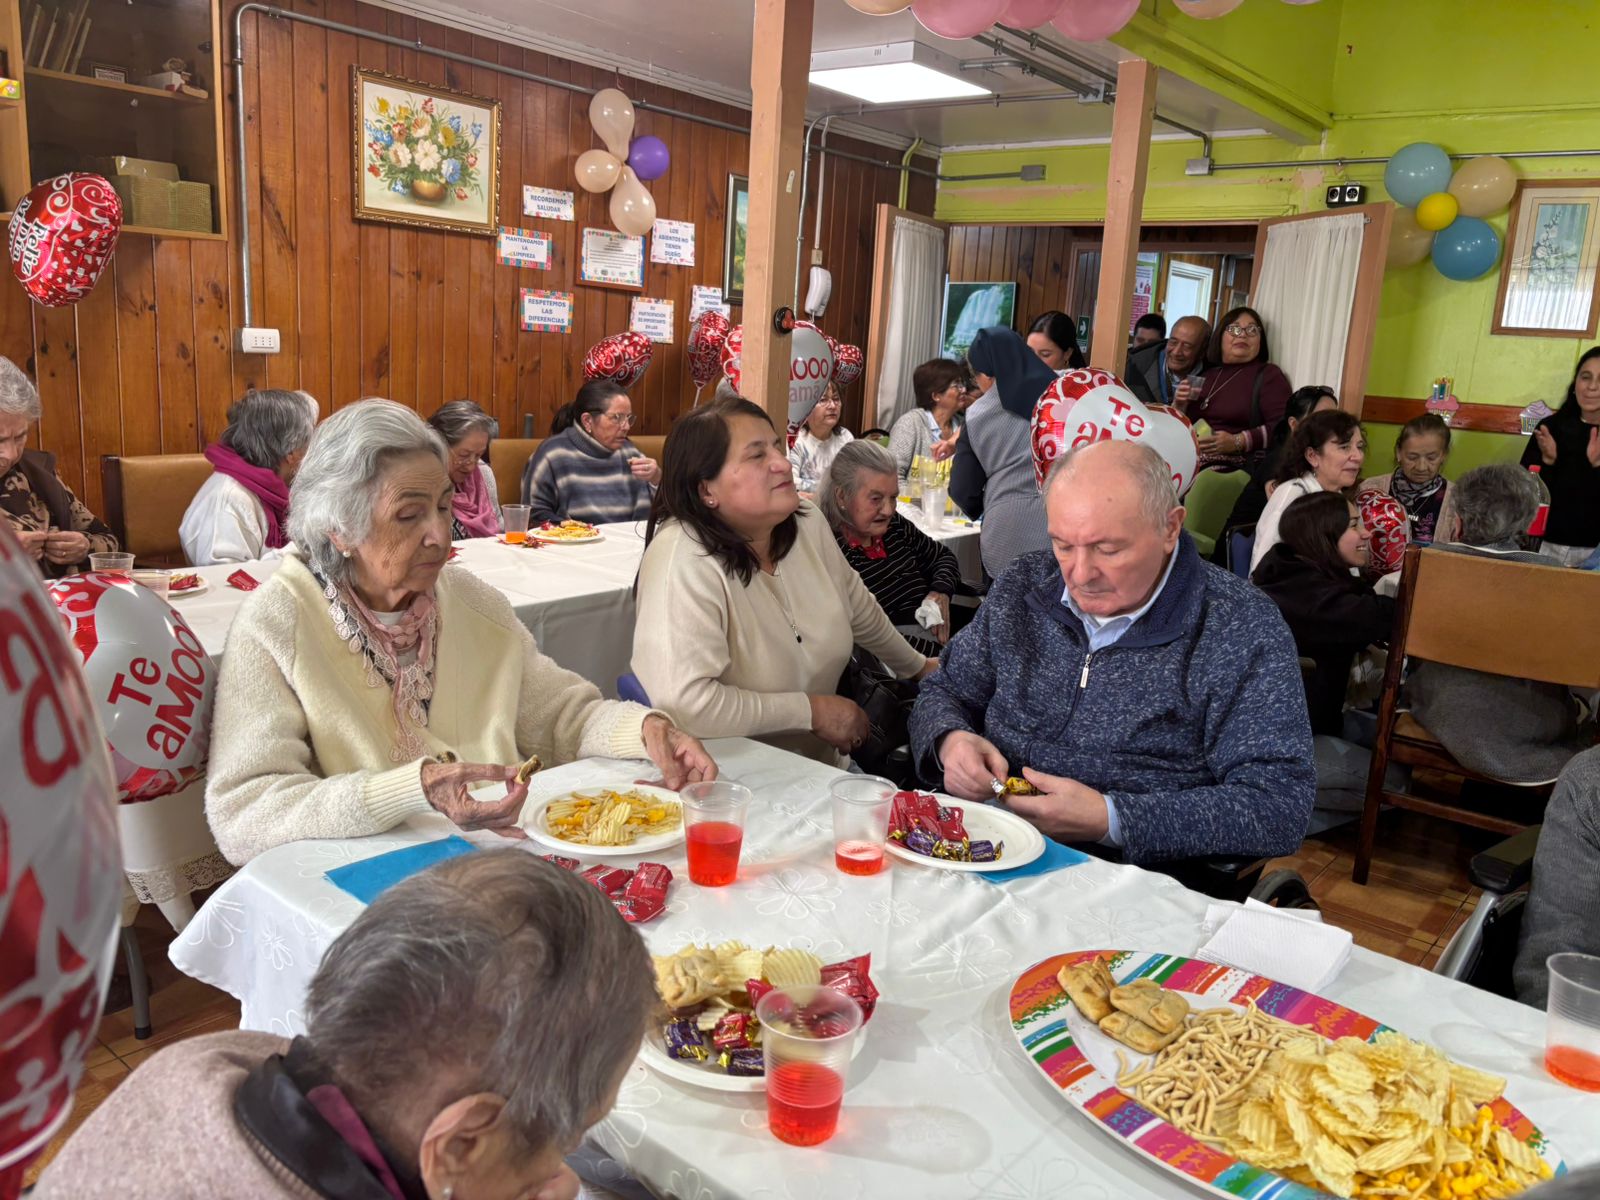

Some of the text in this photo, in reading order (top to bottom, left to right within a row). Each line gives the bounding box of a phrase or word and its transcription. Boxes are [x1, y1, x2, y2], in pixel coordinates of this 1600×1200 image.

[530, 194, 567, 205] RECORDEMOS
[536, 204, 561, 213] SALUDAR
[505, 235, 545, 246] MANTENGAMOS
[22, 217, 47, 276] Feliz
[513, 251, 536, 259] LIMPIEZA
[527, 298, 567, 308] RESPETEMOS
[528, 315, 565, 324] DIFERENCIAS
[1107, 396, 1145, 437] Te
[107, 657, 161, 706] Te
